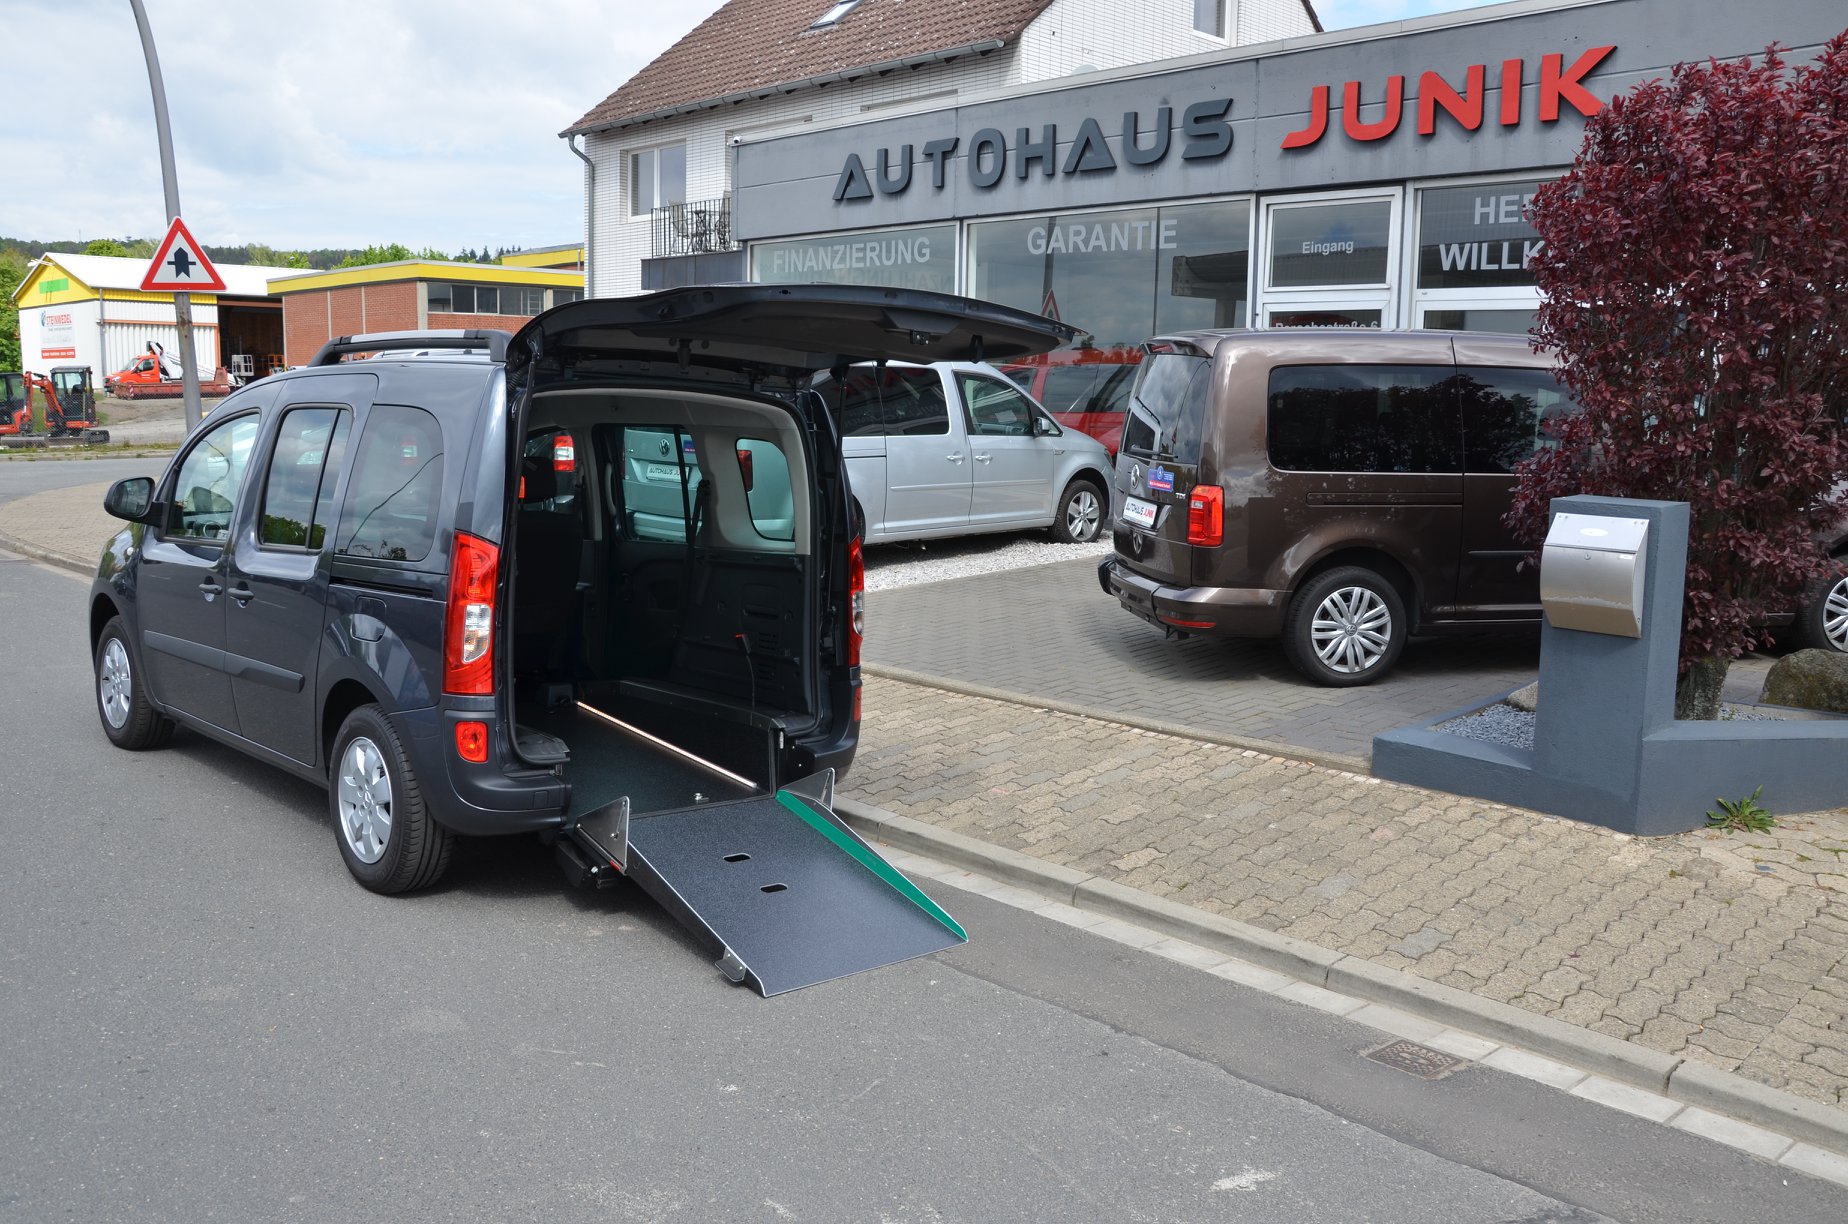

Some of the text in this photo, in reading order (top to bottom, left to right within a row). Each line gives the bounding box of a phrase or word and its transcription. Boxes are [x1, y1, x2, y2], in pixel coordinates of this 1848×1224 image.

[832, 45, 1618, 201] AUTOHAUS JUNIK
[773, 237, 931, 273] FINANZIERUNG
[1026, 219, 1178, 255] GARANTIE
[1302, 241, 1354, 256] Eingang
[1439, 241, 1546, 271] WILLK
